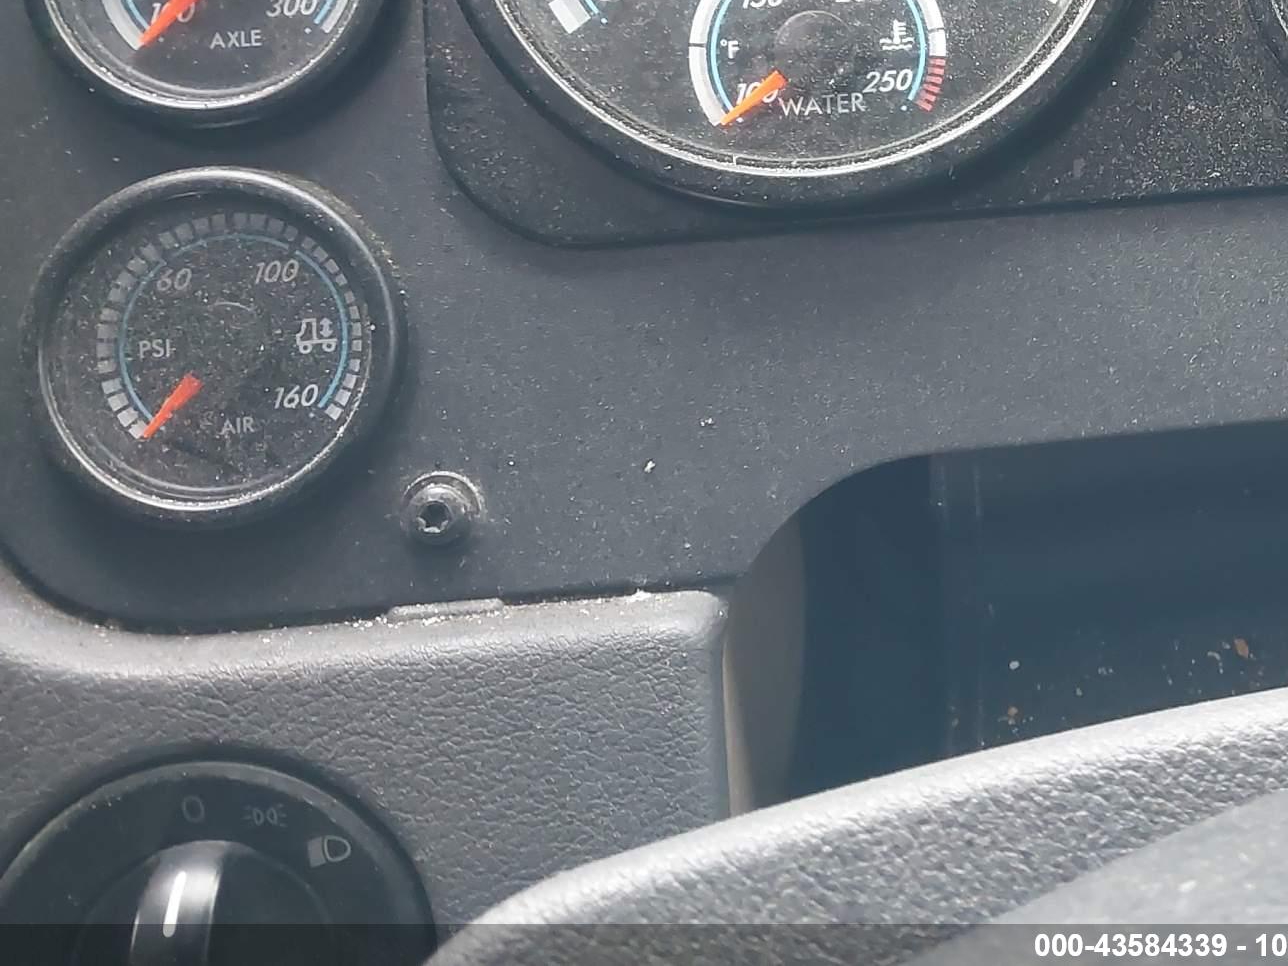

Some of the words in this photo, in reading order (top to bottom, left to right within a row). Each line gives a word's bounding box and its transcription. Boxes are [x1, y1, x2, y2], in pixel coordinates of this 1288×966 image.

[210, 29, 263, 49] AXLE
[862, 69, 913, 94] 250
[778, 92, 866, 116] WATER
[156, 268, 192, 292] 60
[254, 260, 299, 284] 100
[139, 340, 171, 359] PSI
[273, 384, 319, 410] 160
[220, 416, 256, 435] AIR
